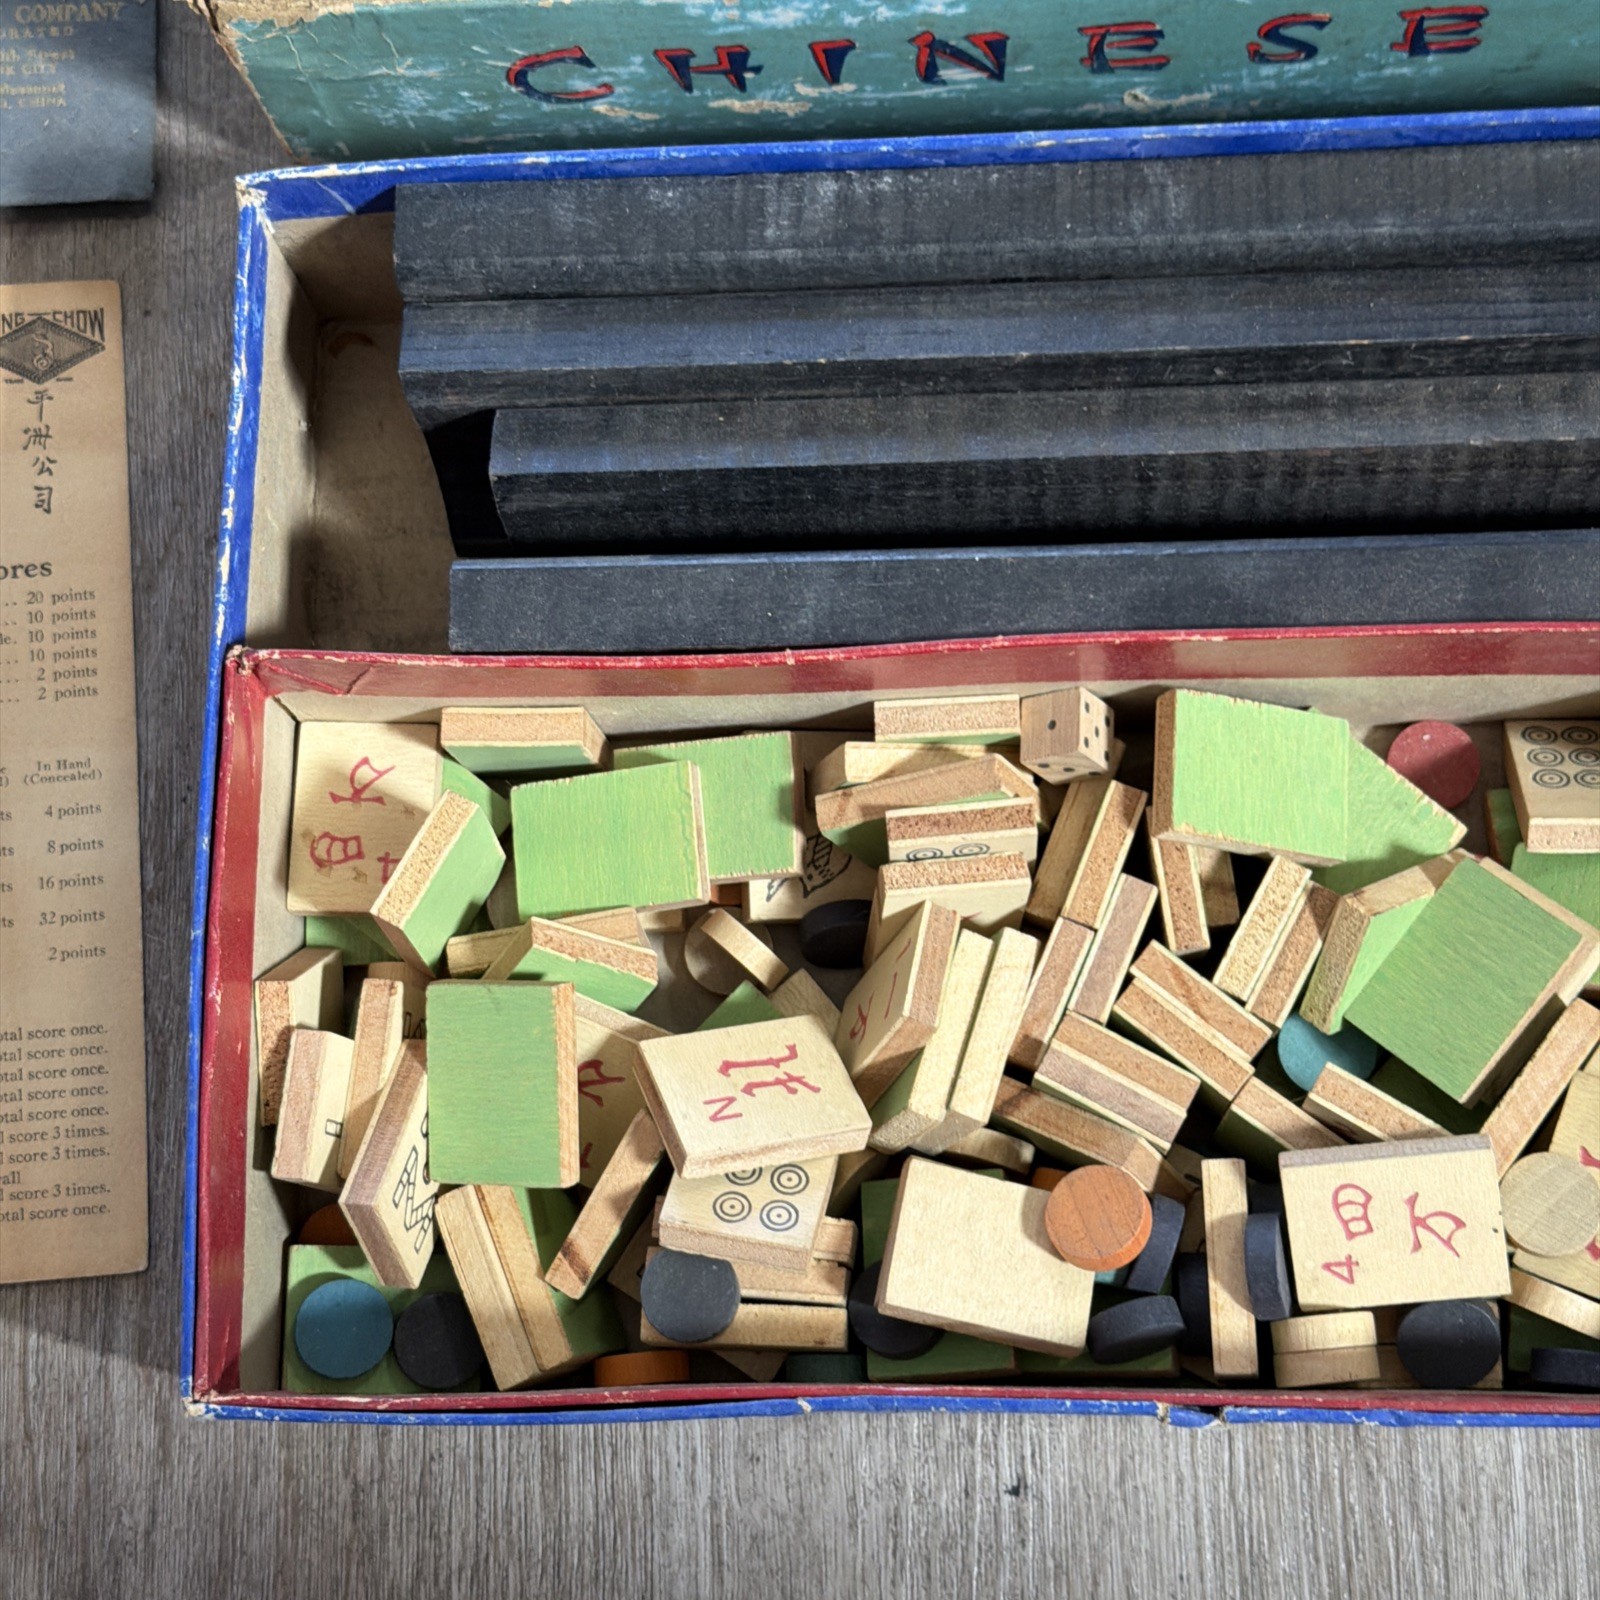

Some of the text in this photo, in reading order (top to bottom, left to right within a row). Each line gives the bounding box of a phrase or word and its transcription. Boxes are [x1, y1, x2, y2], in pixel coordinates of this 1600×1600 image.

[15, 2, 124, 23] COMPANY
[506, 5, 1489, 102] CHINESE
[27, 588, 96, 606] 20 points
[28, 608, 96, 625] 10 points
[29, 629, 44, 643] 10
[52, 628, 97, 644] points
[30, 646, 98, 663] 10 points
[37, 665, 98, 682] 2 points
[38, 684, 99, 701] 2 points
[37, 757, 91, 771] In Hand
[24, 768, 103, 785] (Concealed)
[45, 802, 102, 820] 4 points
[48, 838, 104, 855] 8 points
[39, 873, 104, 890] 16 points
[39, 909, 106, 927] 32 points
[48, 944, 107, 962] 2 points
[27, 1027, 66, 1040] score
[70, 1024, 108, 1036] once.
[27, 1048, 65, 1060] score
[69, 1045, 108, 1057] once.
[28, 1068, 67, 1081] score
[71, 1064, 109, 1077] once.
[27, 1089, 66, 1101] score
[70, 1085, 109, 1097] once.
[28, 1109, 67, 1122] score
[71, 1106, 110, 1118] once.
[703, 1096, 743, 1122] N
[9, 1131, 49, 1144] score
[52, 1126, 61, 1140] 3
[65, 1124, 110, 1138] times.
[9, 1152, 49, 1164] score
[52, 1146, 61, 1160] 3
[66, 1145, 110, 1159] times.
[0, 1171, 21, 1185] all
[10, 1190, 49, 1201] score
[53, 1184, 62, 1198] 3
[65, 1183, 112, 1197] times.
[29, 1208, 69, 1220] score
[72, 1203, 111, 1217] once.
[1322, 1253, 1360, 1285] 4
